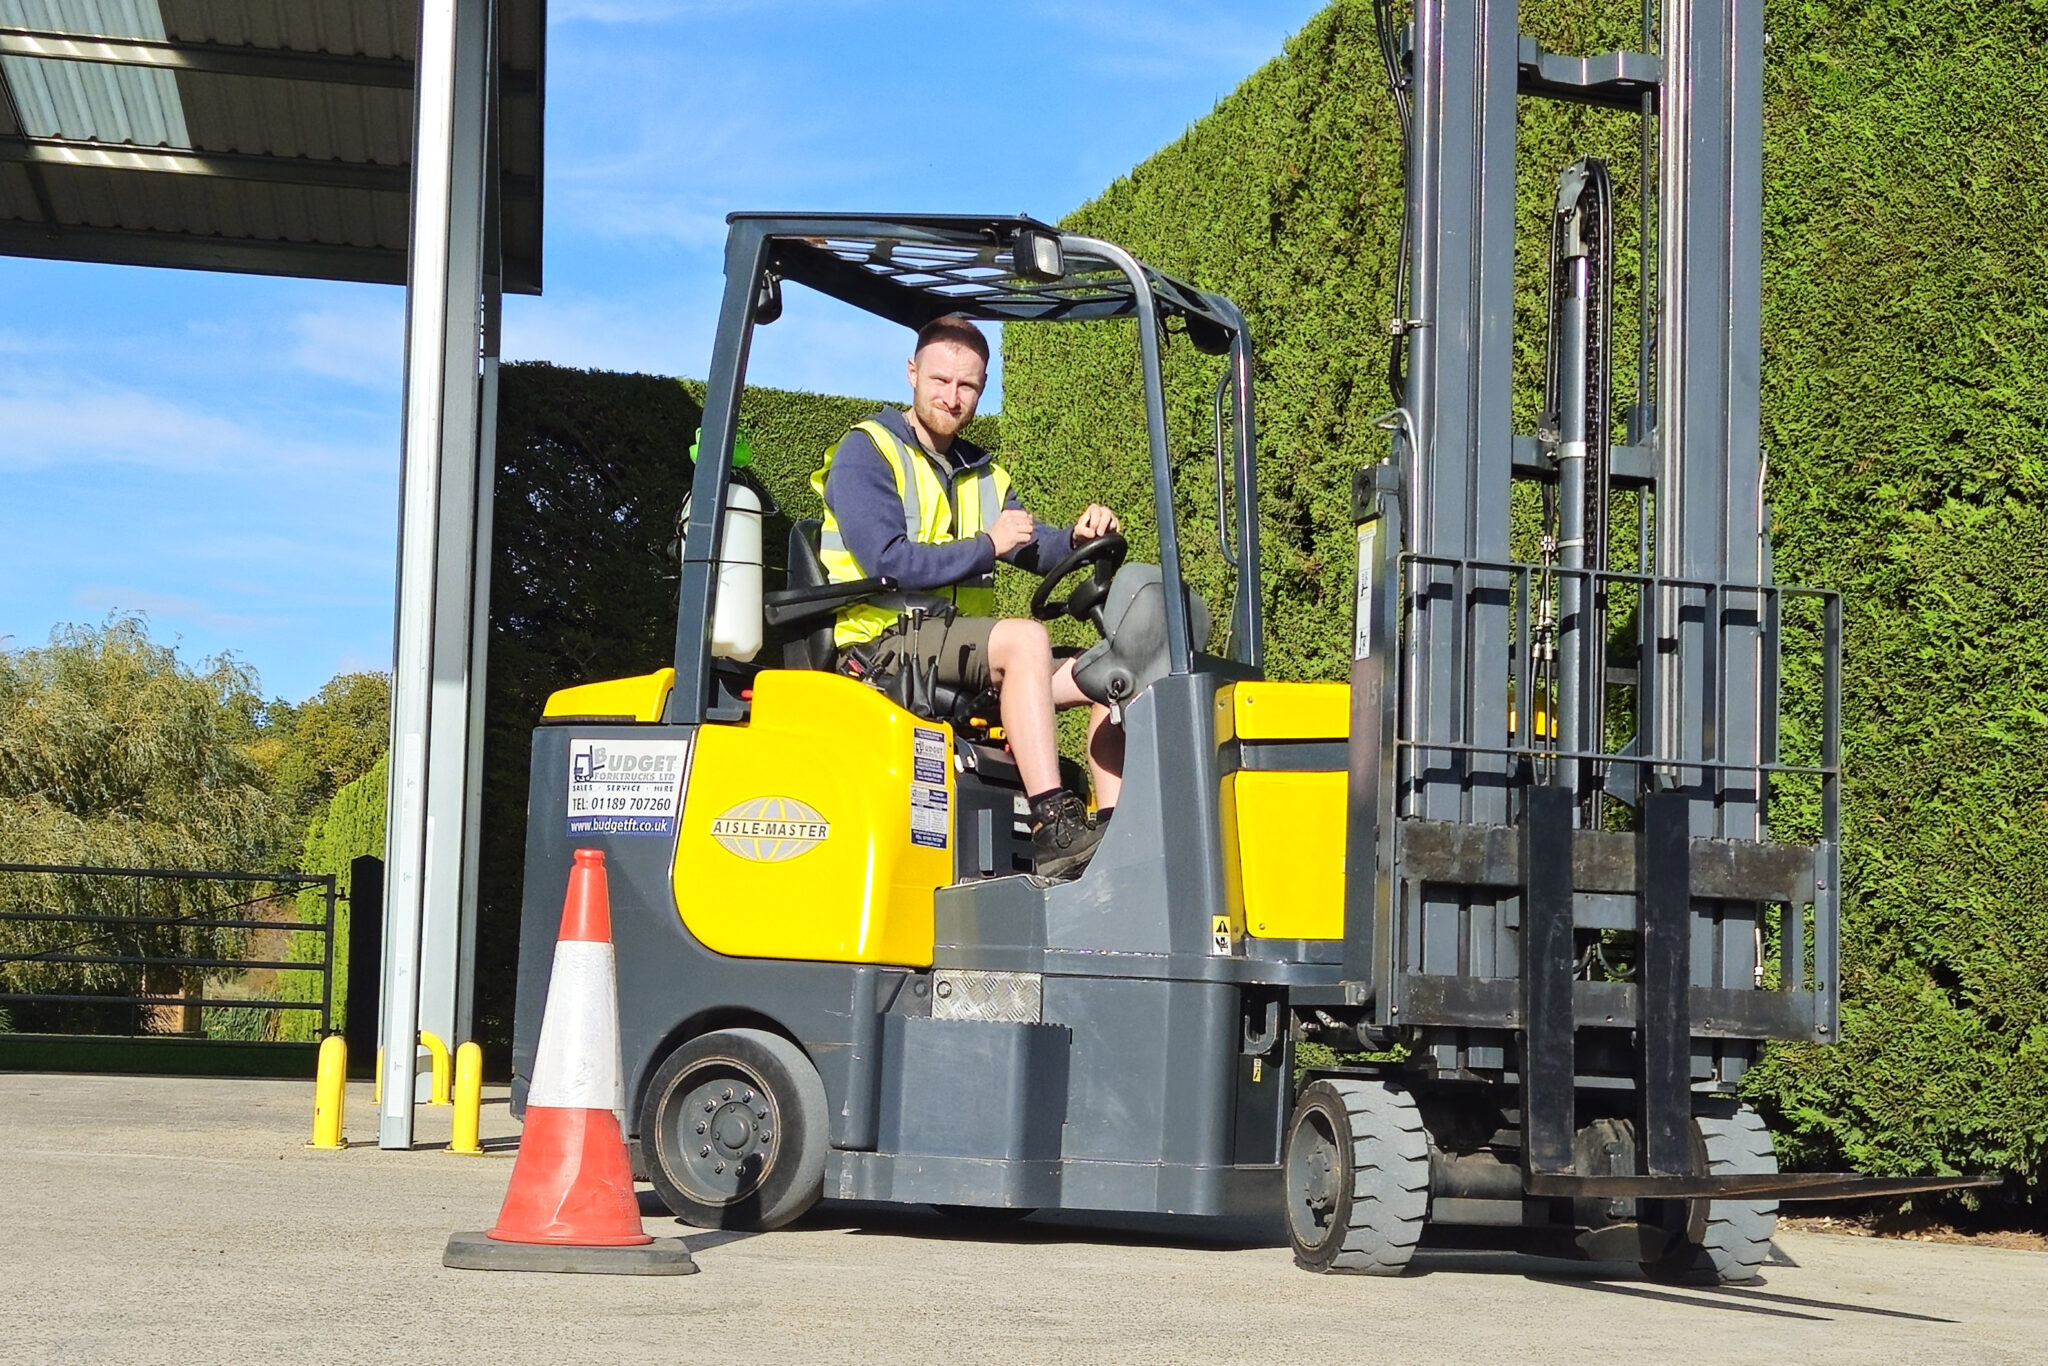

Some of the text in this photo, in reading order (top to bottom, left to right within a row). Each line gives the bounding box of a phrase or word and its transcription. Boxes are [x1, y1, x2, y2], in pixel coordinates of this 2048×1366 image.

[591, 747, 678, 772] BUDGET
[594, 772, 676, 781] FORKTRUCKS LTD
[572, 784, 674, 793] SALES SERVICE HIRE
[572, 797, 671, 811] TEL: 01189 707260
[570, 817, 668, 834] www.budgetft.co.uk
[713, 821, 827, 838] AISLE-MASTER
